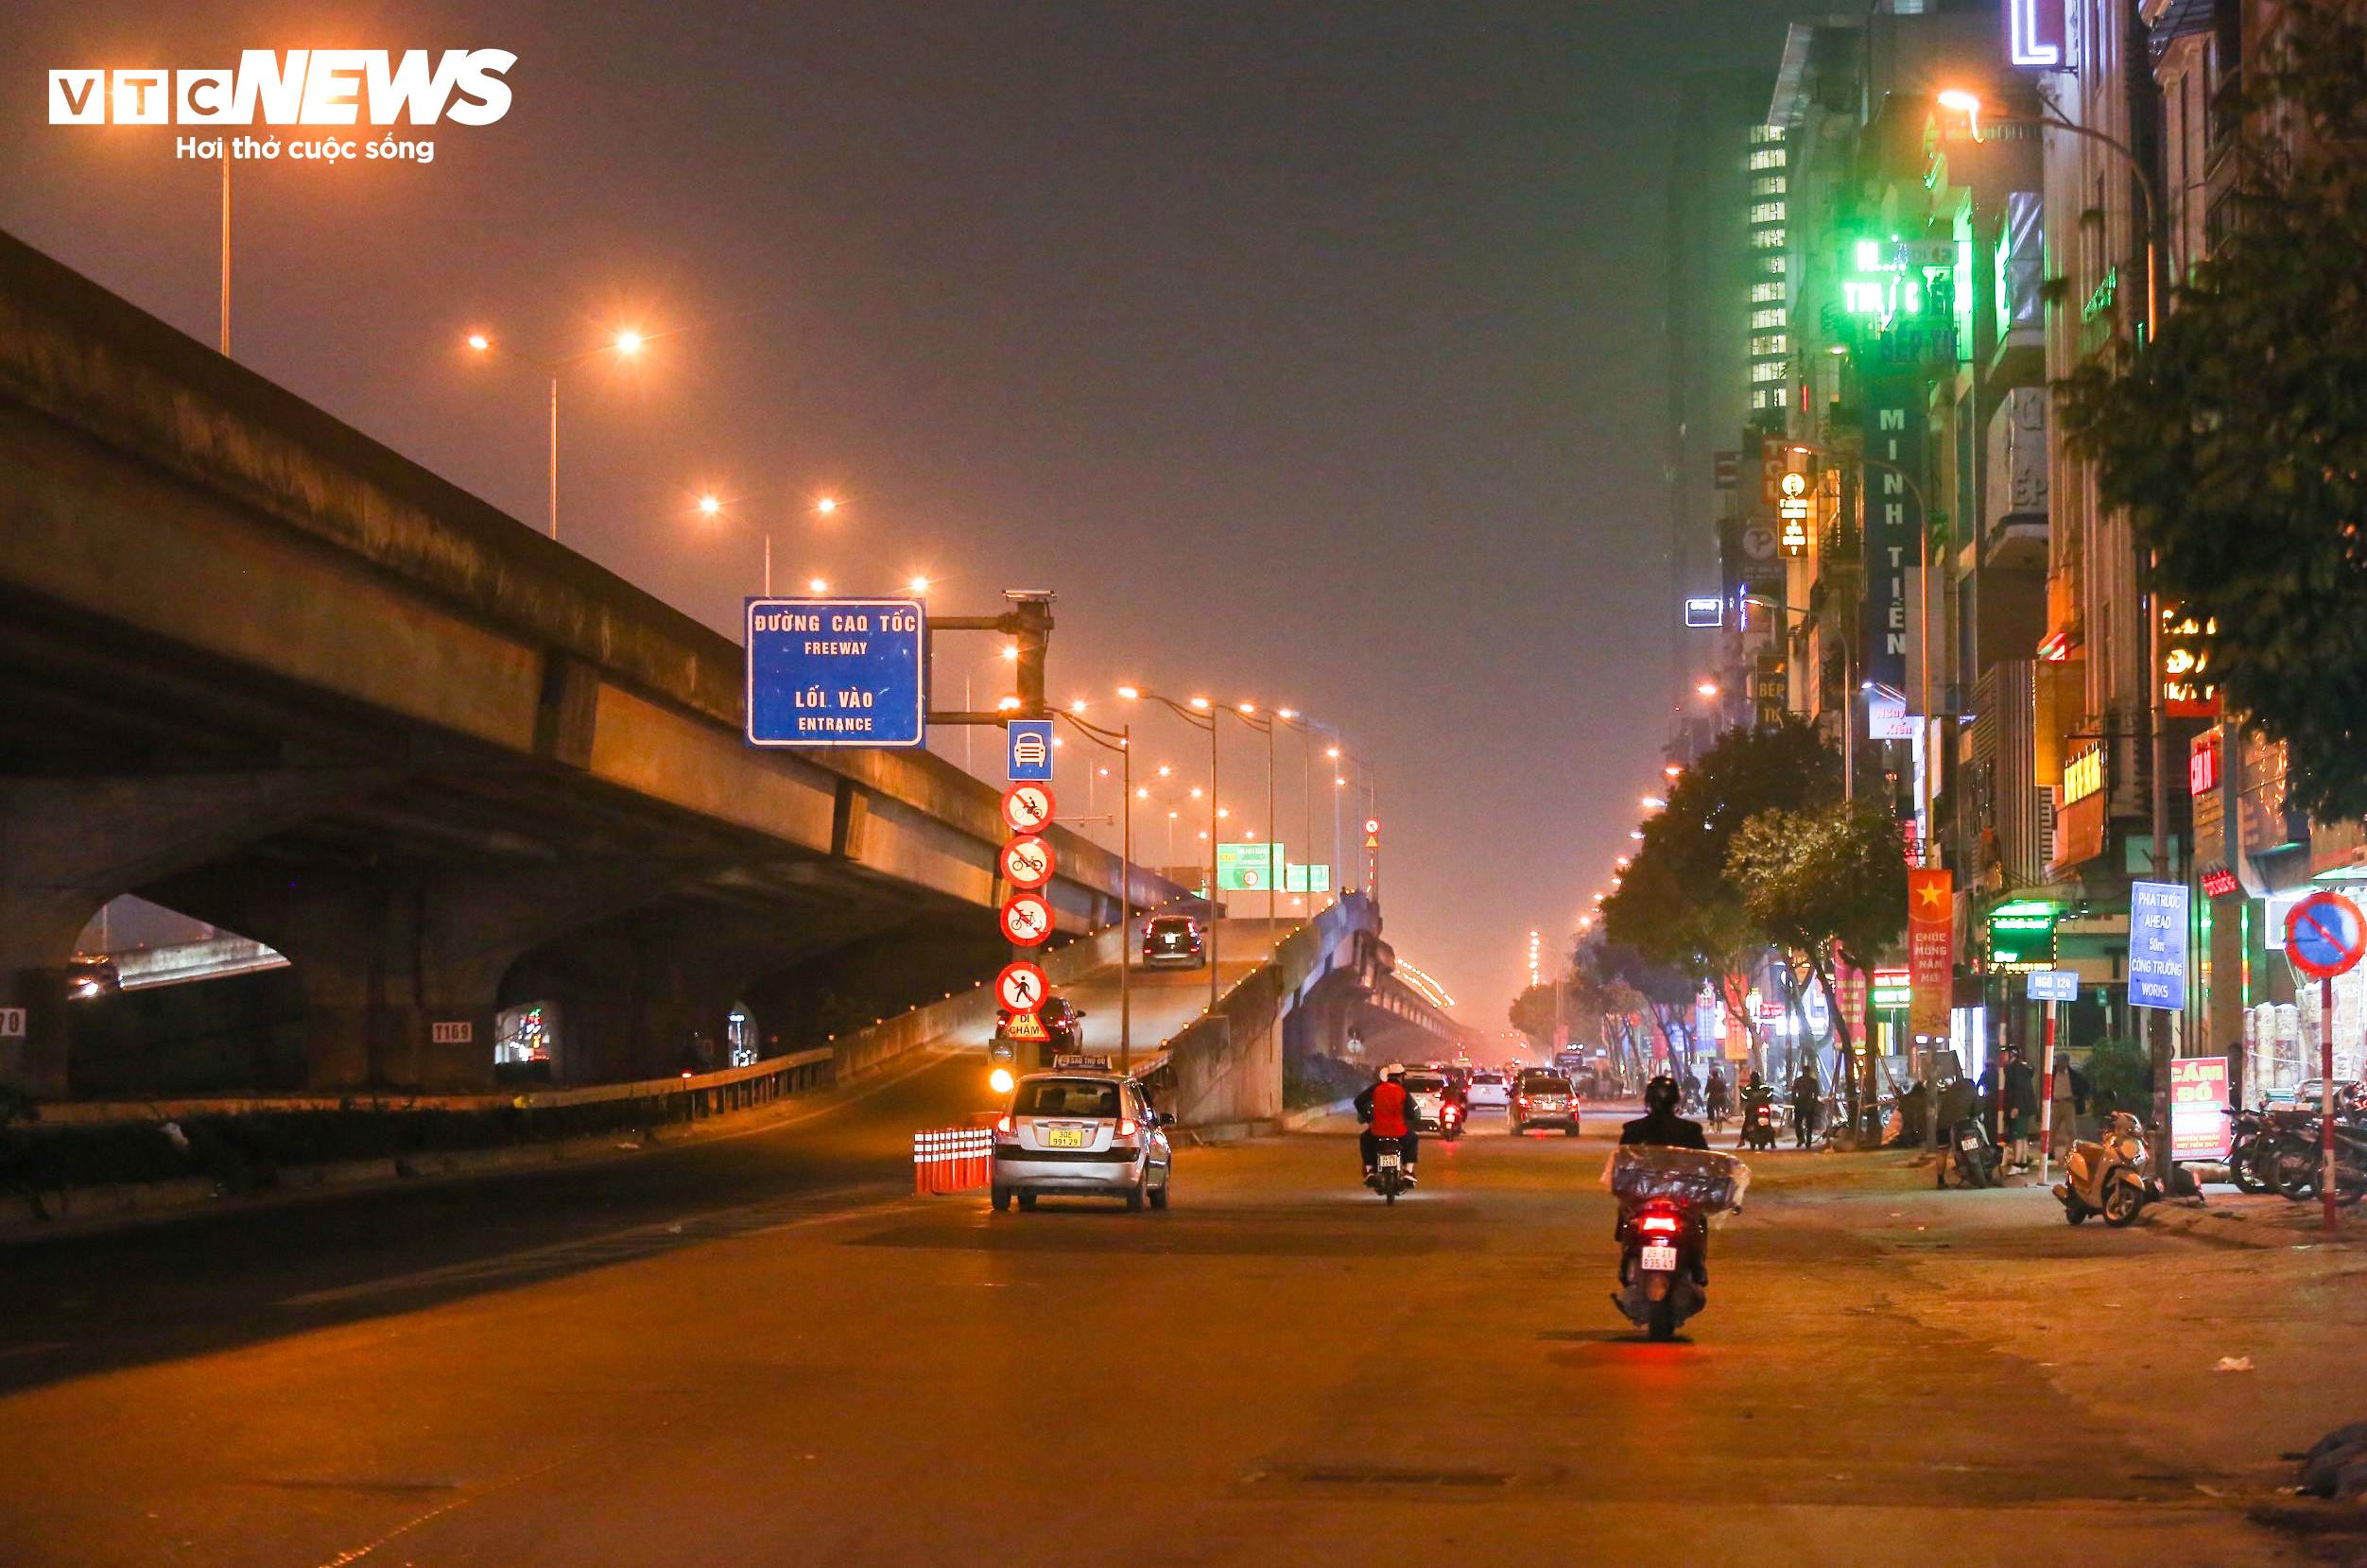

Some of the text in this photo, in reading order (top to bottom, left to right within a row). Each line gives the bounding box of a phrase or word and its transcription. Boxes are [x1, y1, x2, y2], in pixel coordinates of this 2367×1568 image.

[1879, 408, 1905, 525] MINH
[754, 610, 916, 632] ĐƯỜNG CAO TỐC
[804, 642, 868, 656] FREEWAY
[795, 685, 873, 708] LỐI VÀO
[799, 717, 873, 732] ENTRANCE
[2145, 914, 2170, 929] AHEAD
[2149, 937, 2165, 952] 50m
[2141, 983, 2168, 998] WORKS
